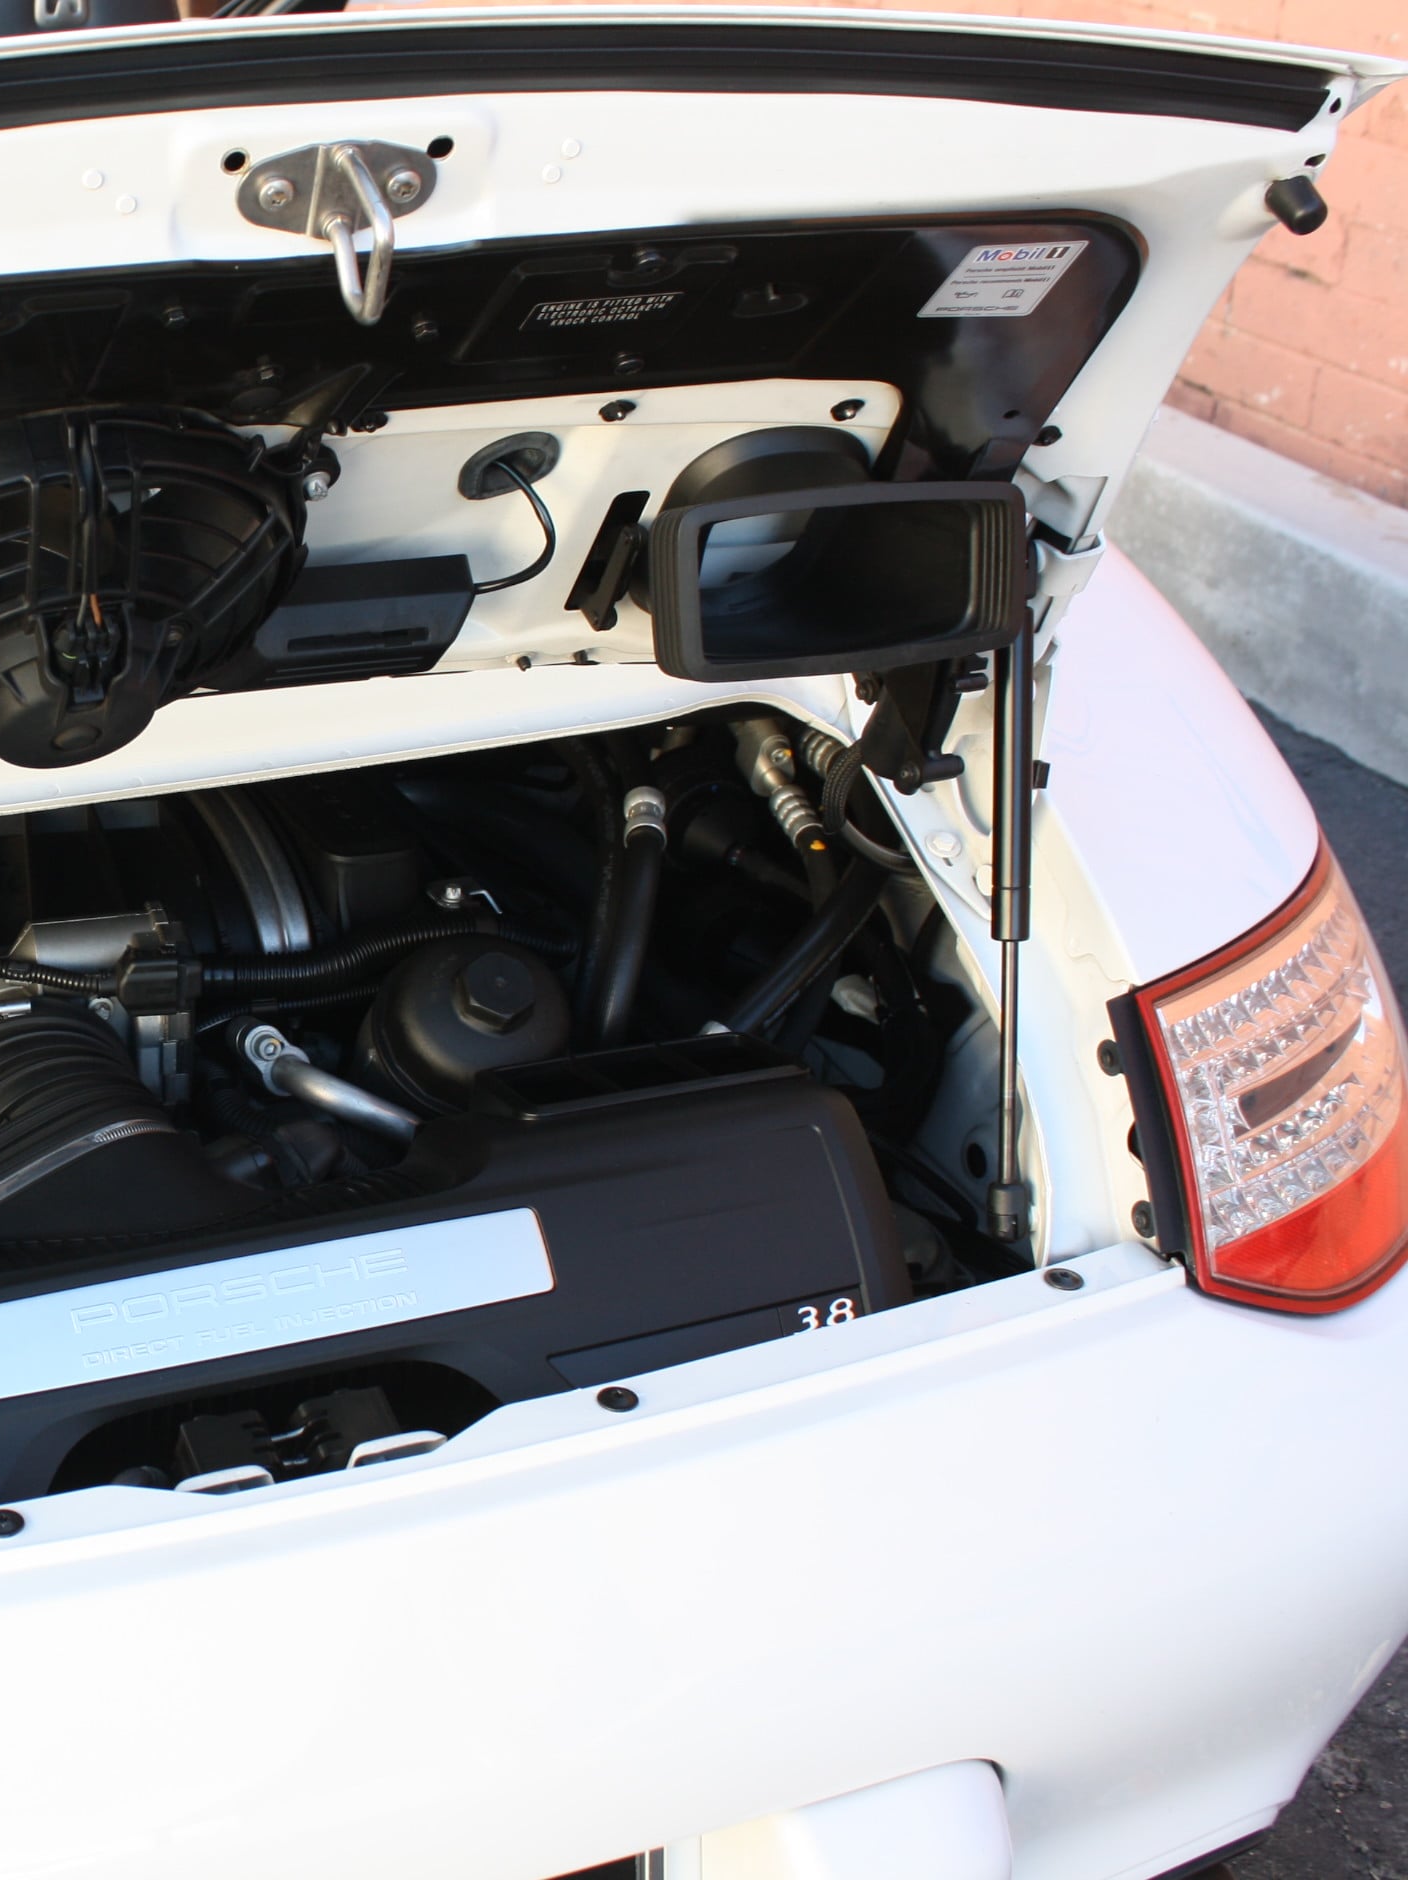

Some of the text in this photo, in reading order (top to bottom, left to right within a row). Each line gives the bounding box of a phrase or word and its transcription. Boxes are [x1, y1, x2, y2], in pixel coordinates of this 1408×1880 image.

[976, 247, 1046, 262] Mobil
[541, 295, 674, 313] ENGINE IS FITTED WITH
[536, 307, 606, 321] ELECTRONIC
[550, 312, 640, 327] KNOCK CONTROL
[71, 1247, 408, 1335] PORSCHE
[82, 1290, 419, 1369] DIRECT FUEL INJECTION
